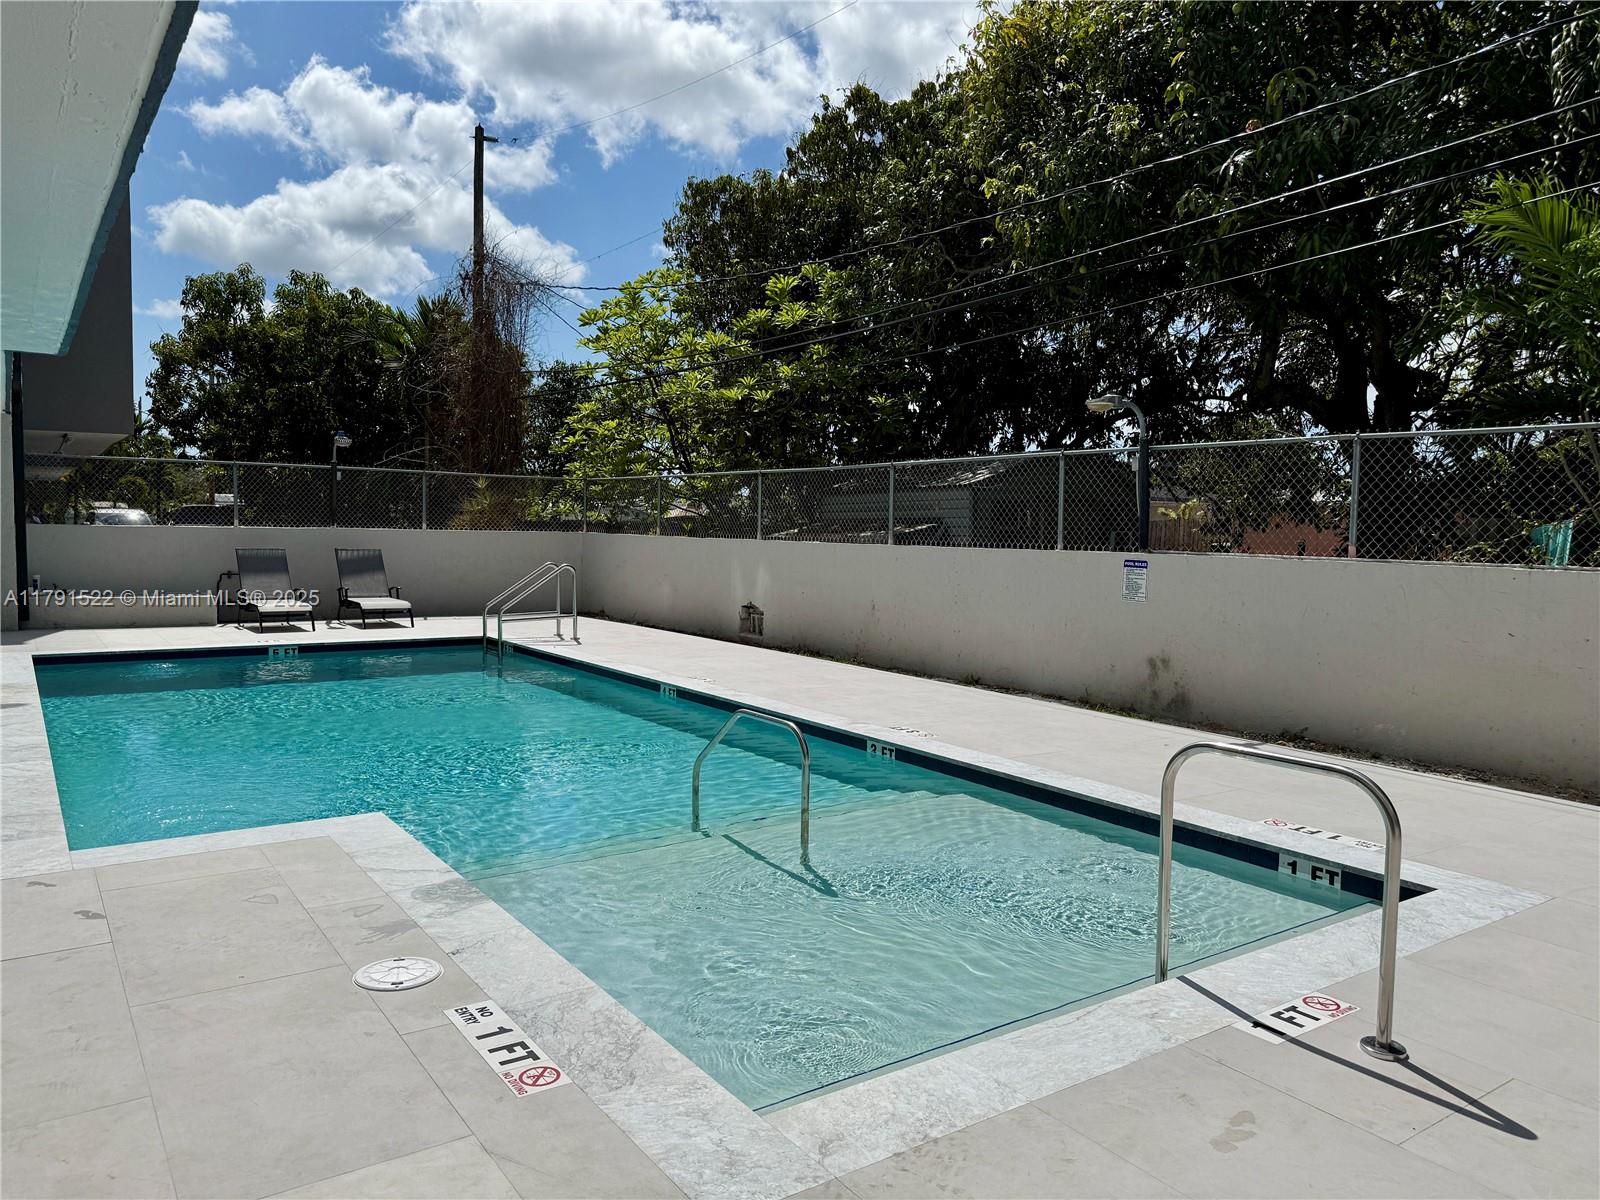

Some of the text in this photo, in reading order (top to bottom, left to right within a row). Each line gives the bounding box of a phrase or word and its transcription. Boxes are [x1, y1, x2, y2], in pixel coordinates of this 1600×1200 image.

[881, 746, 895, 758] FT
[1287, 860, 1340, 886] 1 FT
[454, 1006, 481, 1025] ENTRY
[475, 1006, 494, 1018] NO
[1251, 1005, 1321, 1036] 1 FT
[475, 1026, 541, 1066] 1 FT
[501, 1071, 528, 1096] NO DIVING
